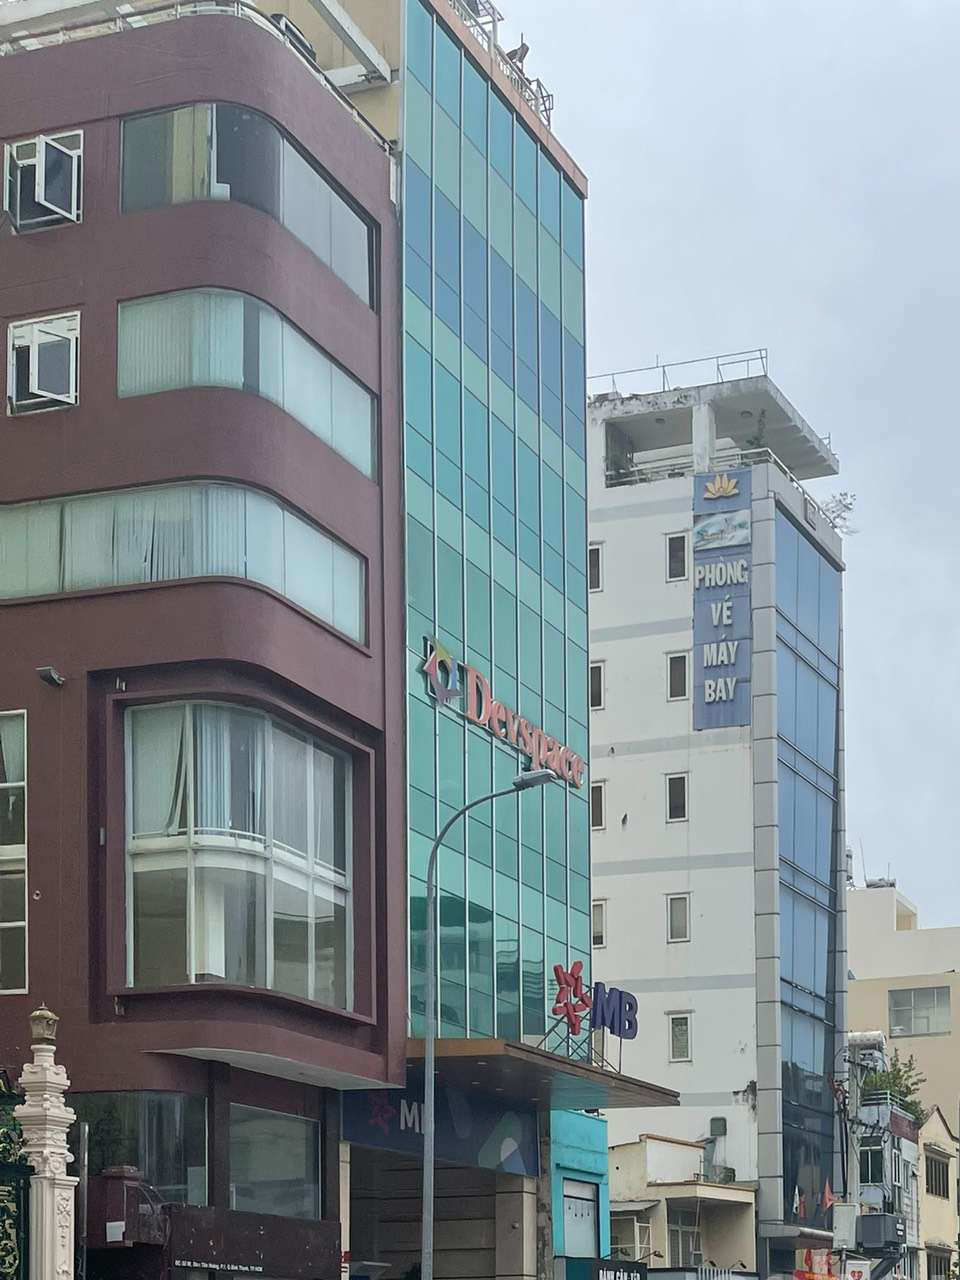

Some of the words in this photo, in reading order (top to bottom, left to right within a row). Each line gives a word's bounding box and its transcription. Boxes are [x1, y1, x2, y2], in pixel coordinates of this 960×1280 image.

[695, 556, 749, 590] PHÒNG
[711, 595, 733, 626] VÉ
[703, 634, 738, 668] MÁY
[704, 677, 737, 704] BAY
[591, 981, 639, 1040] MB
